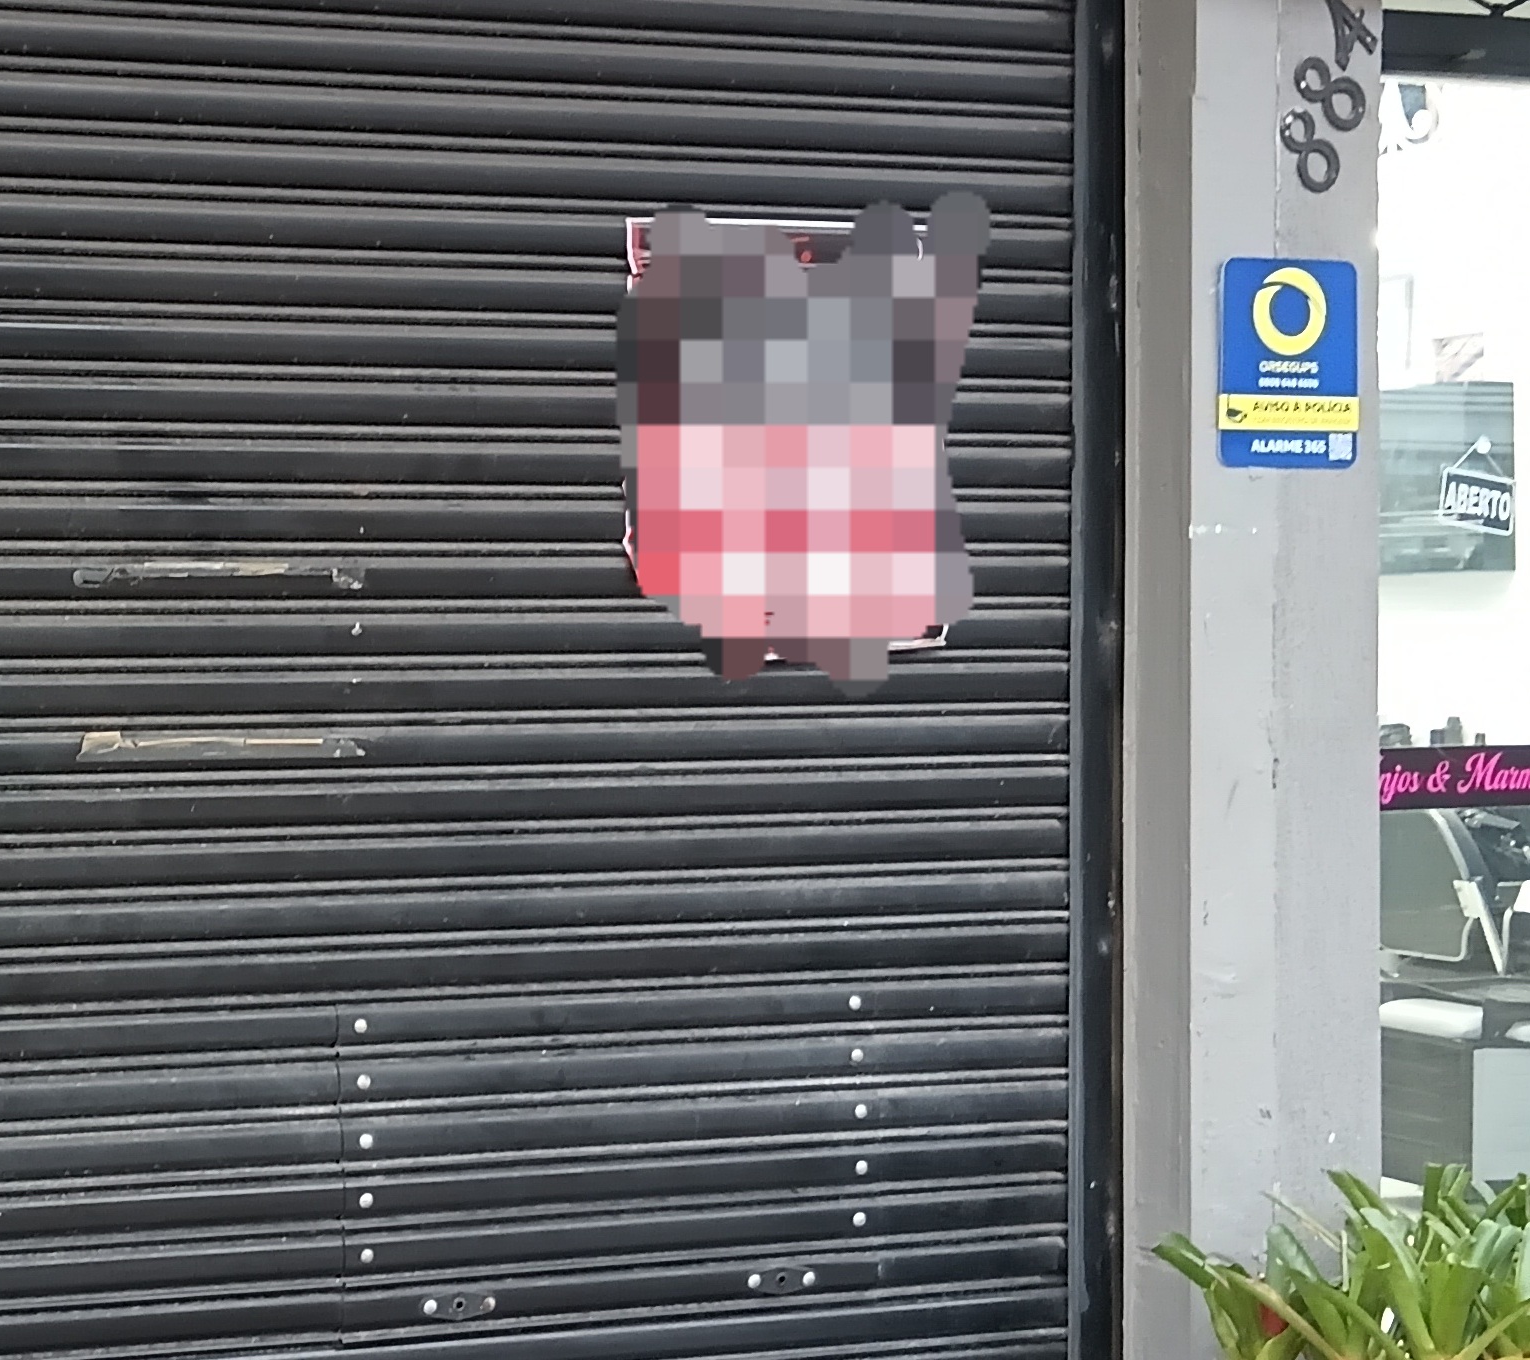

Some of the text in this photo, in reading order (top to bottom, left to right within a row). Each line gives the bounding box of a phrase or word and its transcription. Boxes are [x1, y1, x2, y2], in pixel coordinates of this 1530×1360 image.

[1251, 438, 1303, 454] ALARME
[1444, 481, 1511, 521] ABERTO
[1427, 760, 1451, 793] &
